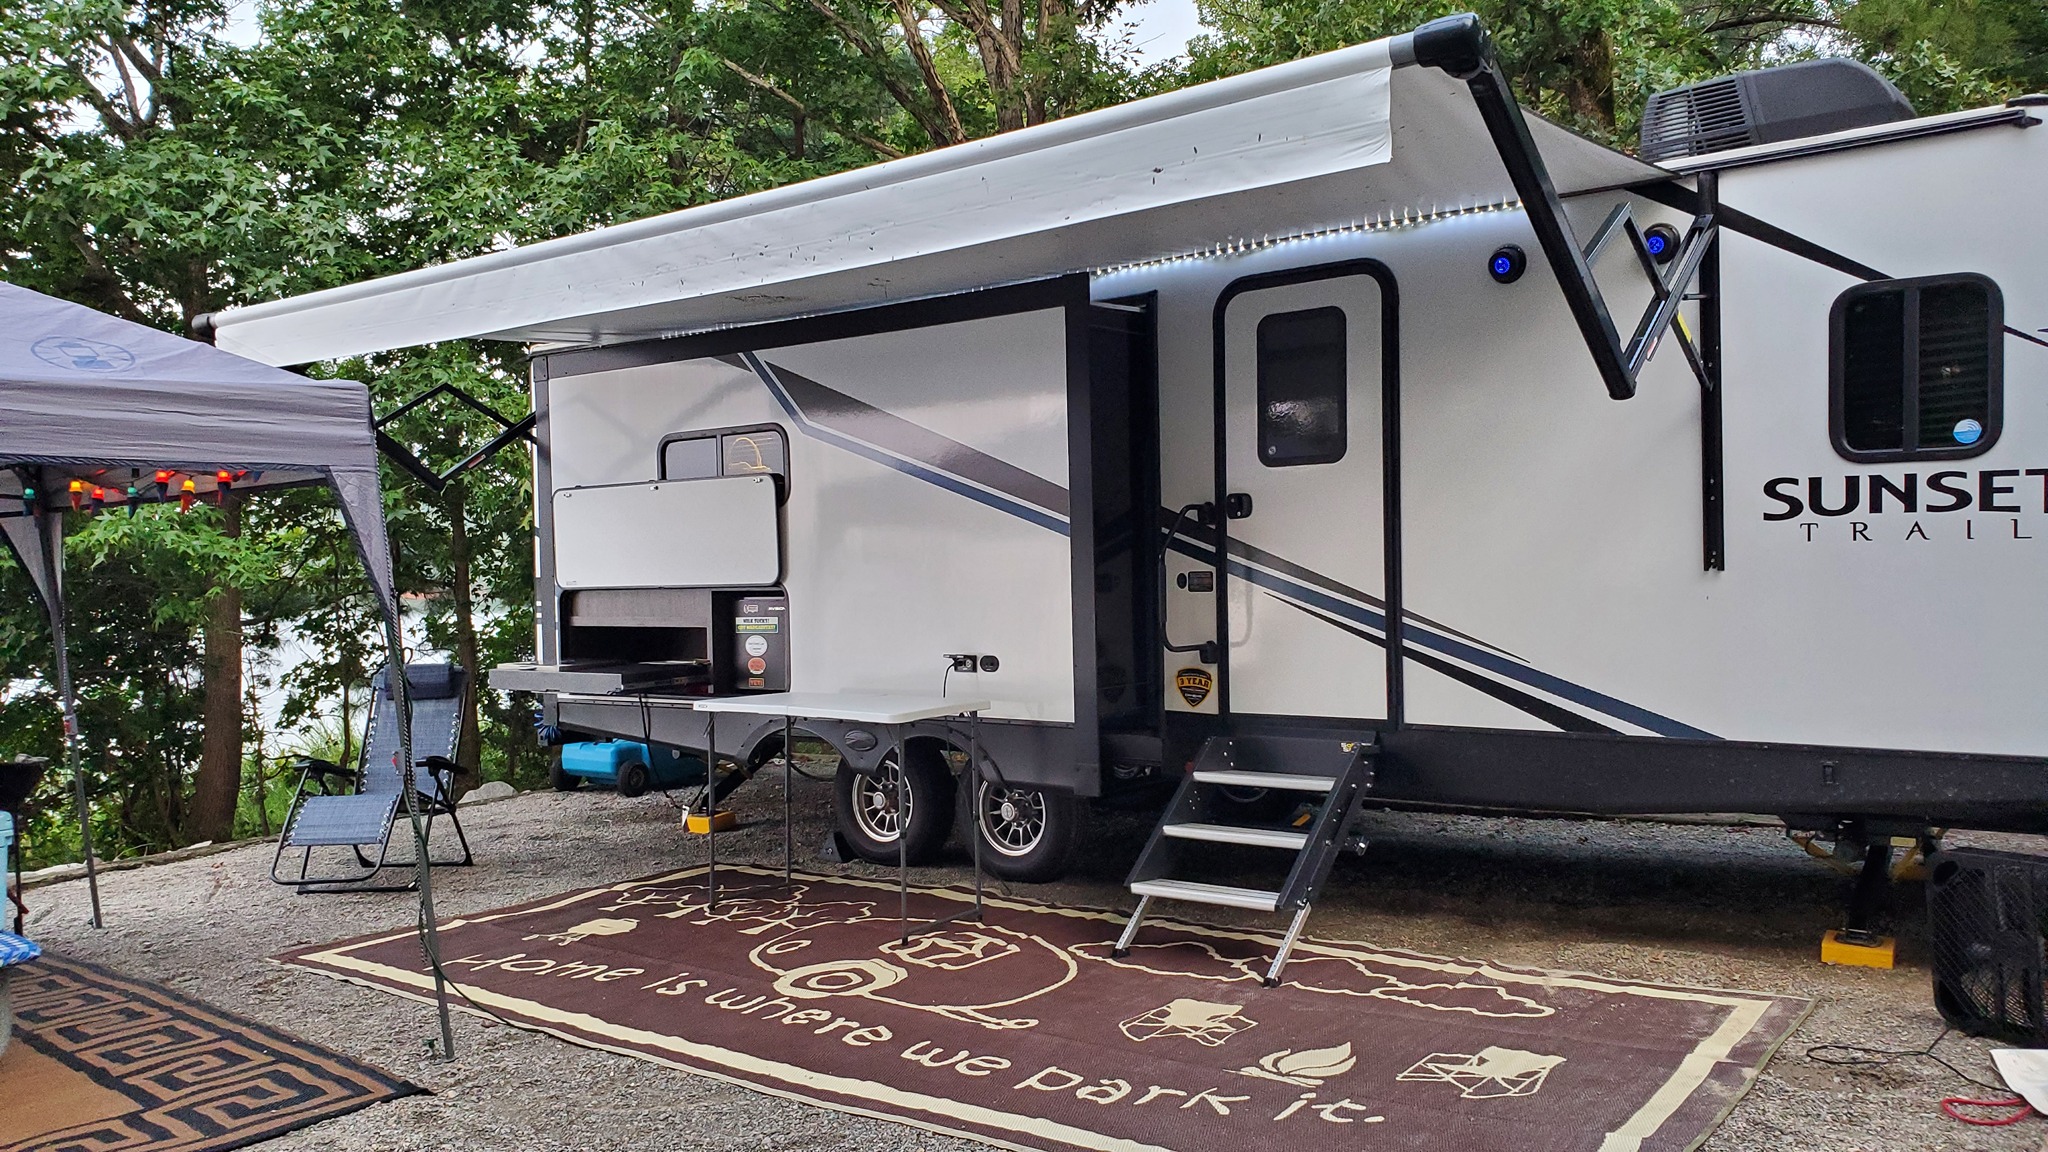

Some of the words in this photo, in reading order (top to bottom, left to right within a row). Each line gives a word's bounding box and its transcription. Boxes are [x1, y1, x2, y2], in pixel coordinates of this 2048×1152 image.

[1800, 519, 2033, 542] TRAIL
[1186, 677, 1210, 689] YEAR
[422, 953, 645, 982] Home
[640, 972, 708, 996] is
[704, 987, 893, 1047] where
[900, 1040, 1013, 1077] we
[1012, 1066, 1251, 1117] park
[1273, 1092, 1385, 1122] it.
